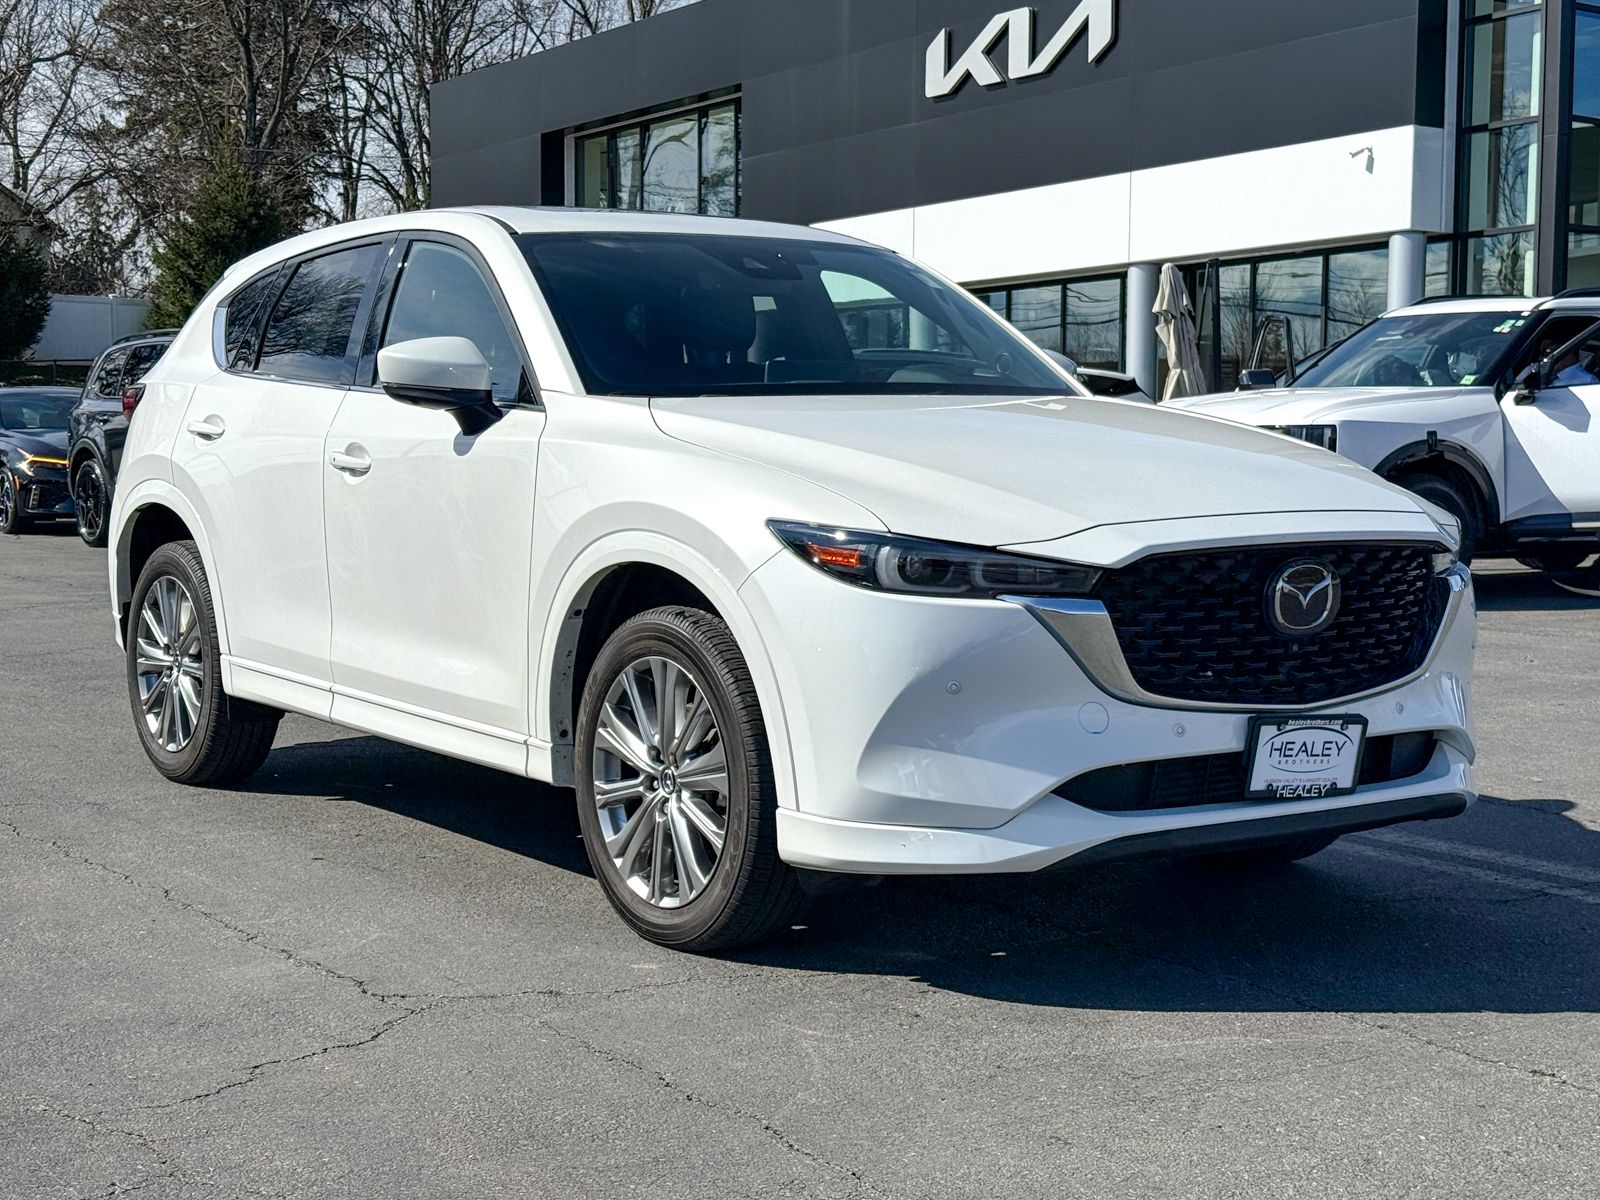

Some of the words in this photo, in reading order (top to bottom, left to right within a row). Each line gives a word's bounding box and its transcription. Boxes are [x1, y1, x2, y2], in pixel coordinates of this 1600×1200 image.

[925, 0, 1113, 98] KIA
[1268, 740, 1347, 758] HEALEY
[1276, 784, 1329, 798] HEALEY
